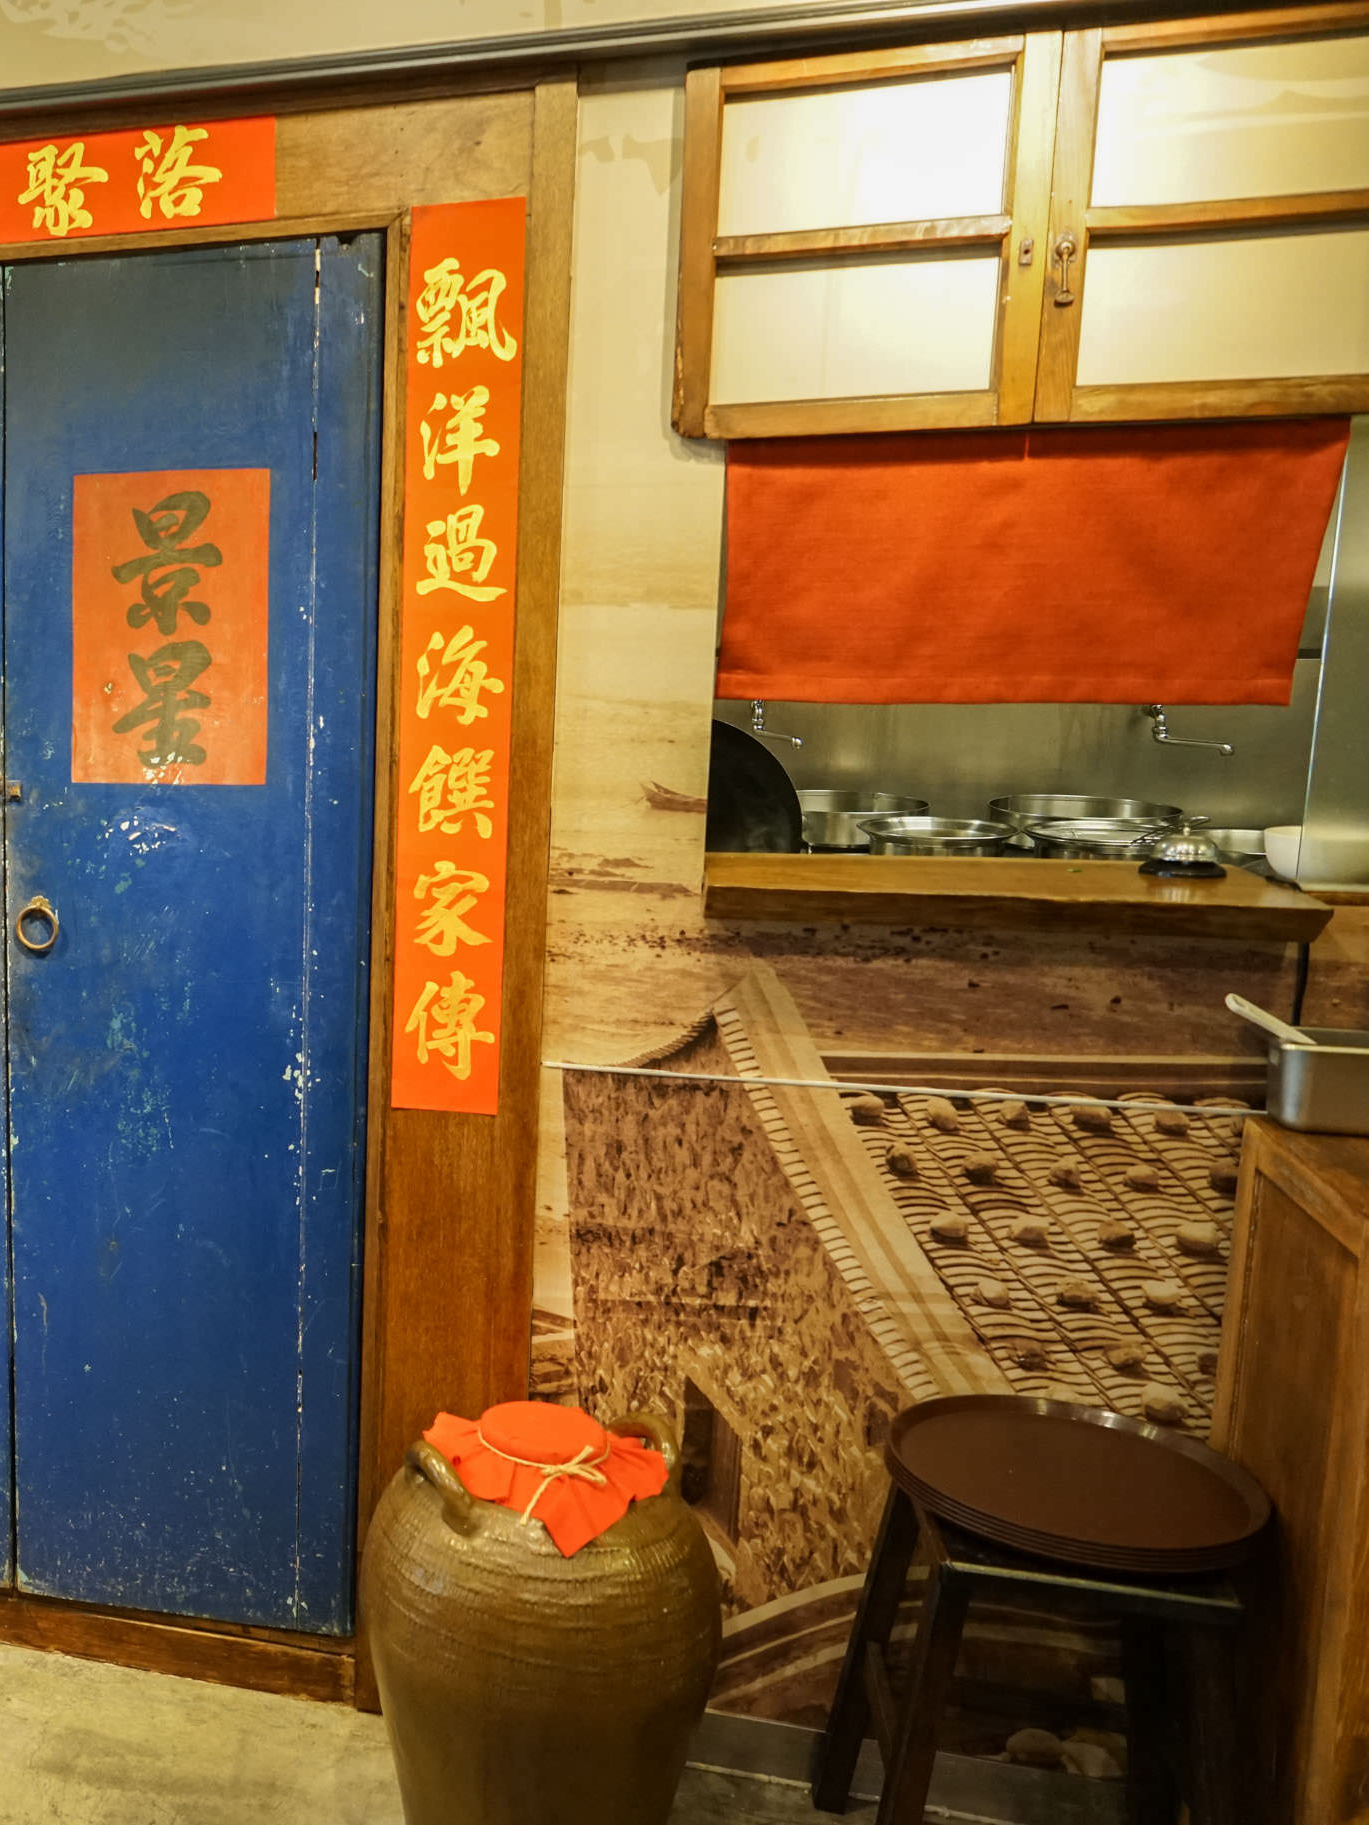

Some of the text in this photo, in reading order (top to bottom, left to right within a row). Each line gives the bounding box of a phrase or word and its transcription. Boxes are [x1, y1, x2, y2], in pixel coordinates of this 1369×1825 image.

[110, 490, 223, 768] 景星
[404, 257, 517, 1081] 飄洋過海饌家傳
